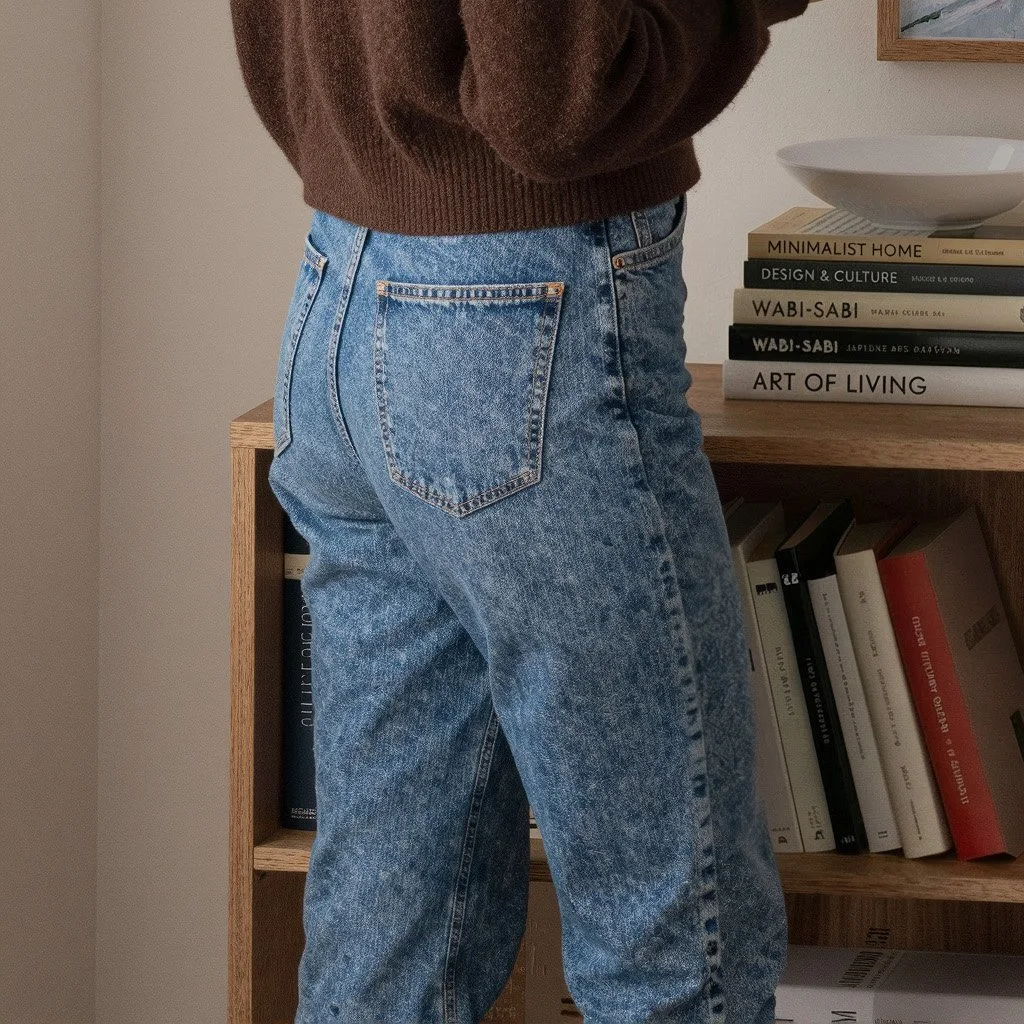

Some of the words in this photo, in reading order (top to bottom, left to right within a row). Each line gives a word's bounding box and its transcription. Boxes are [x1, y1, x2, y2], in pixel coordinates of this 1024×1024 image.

[767, 240, 867, 256] MINIMALIST
[872, 243, 922, 258] HOME
[761, 267, 815, 282] DESIGN
[820, 269, 830, 282] &
[834, 270, 898, 284] CULTURE
[752, 300, 858, 319] WABI-SABI
[752, 337, 839, 354] WABI-SABI
[752, 372, 796, 391] ART
[804, 373, 837, 392] OF
[847, 374, 927, 395] LIVING
